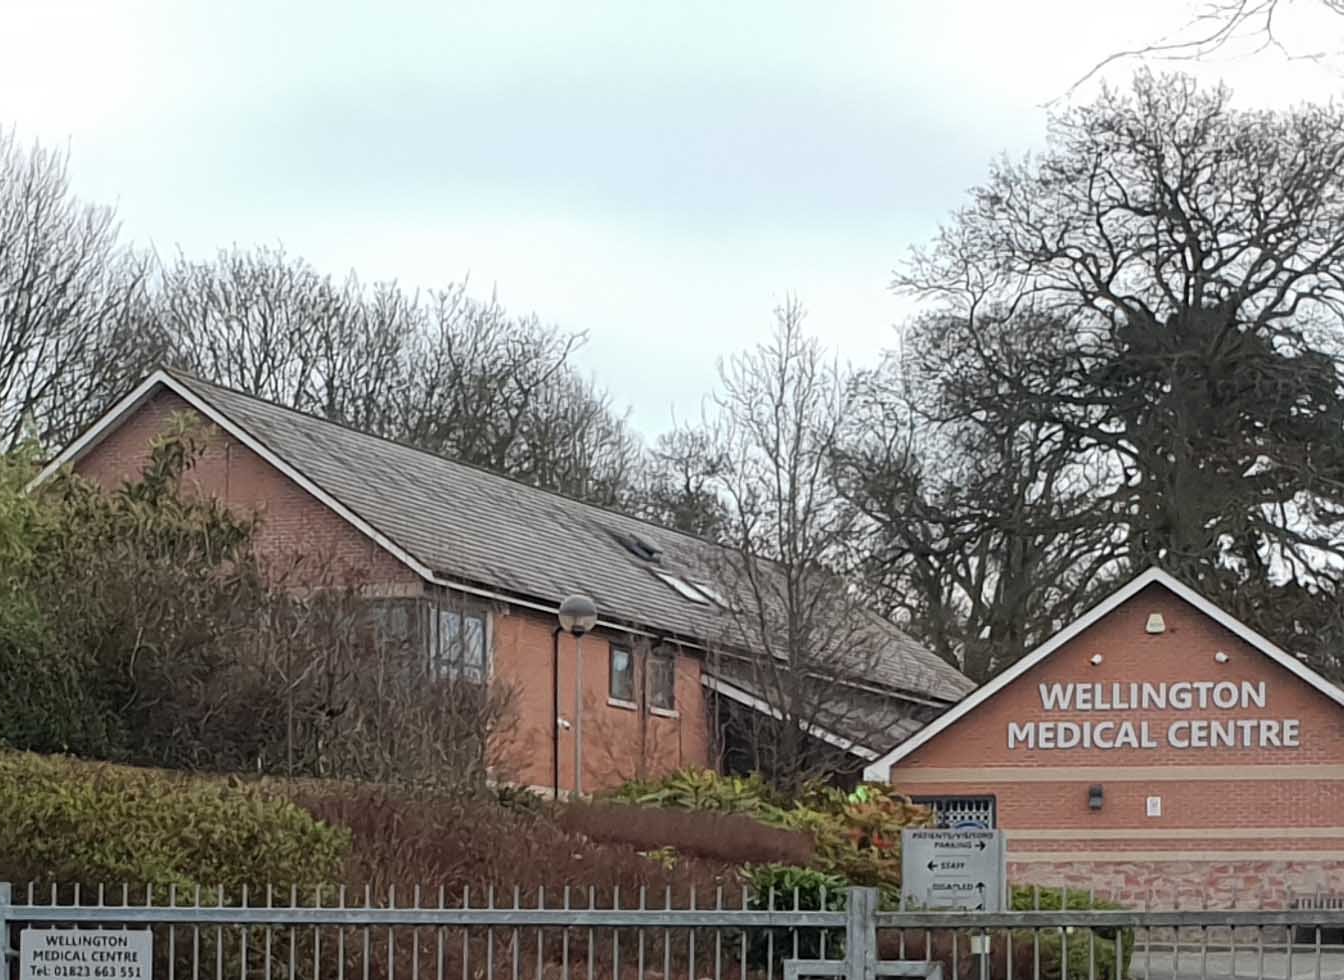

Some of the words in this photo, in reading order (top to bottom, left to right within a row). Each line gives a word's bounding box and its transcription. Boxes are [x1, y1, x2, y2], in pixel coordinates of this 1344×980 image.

[1039, 681, 1266, 710] WELLINGTON
[1008, 721, 1157, 749] MEDICAL
[1167, 719, 1300, 748] CENTRE
[934, 841, 972, 849] PARKING
[941, 861, 965, 870] STAFF
[46, 936, 128, 947] WELLINGTON
[32, 950, 87, 962] MEDICAL
[91, 951, 138, 963] CENTRE
[31, 965, 51, 976] Tel:
[54, 966, 90, 977] 01823
[94, 966, 116, 977] 663
[120, 967, 141, 978] 551
